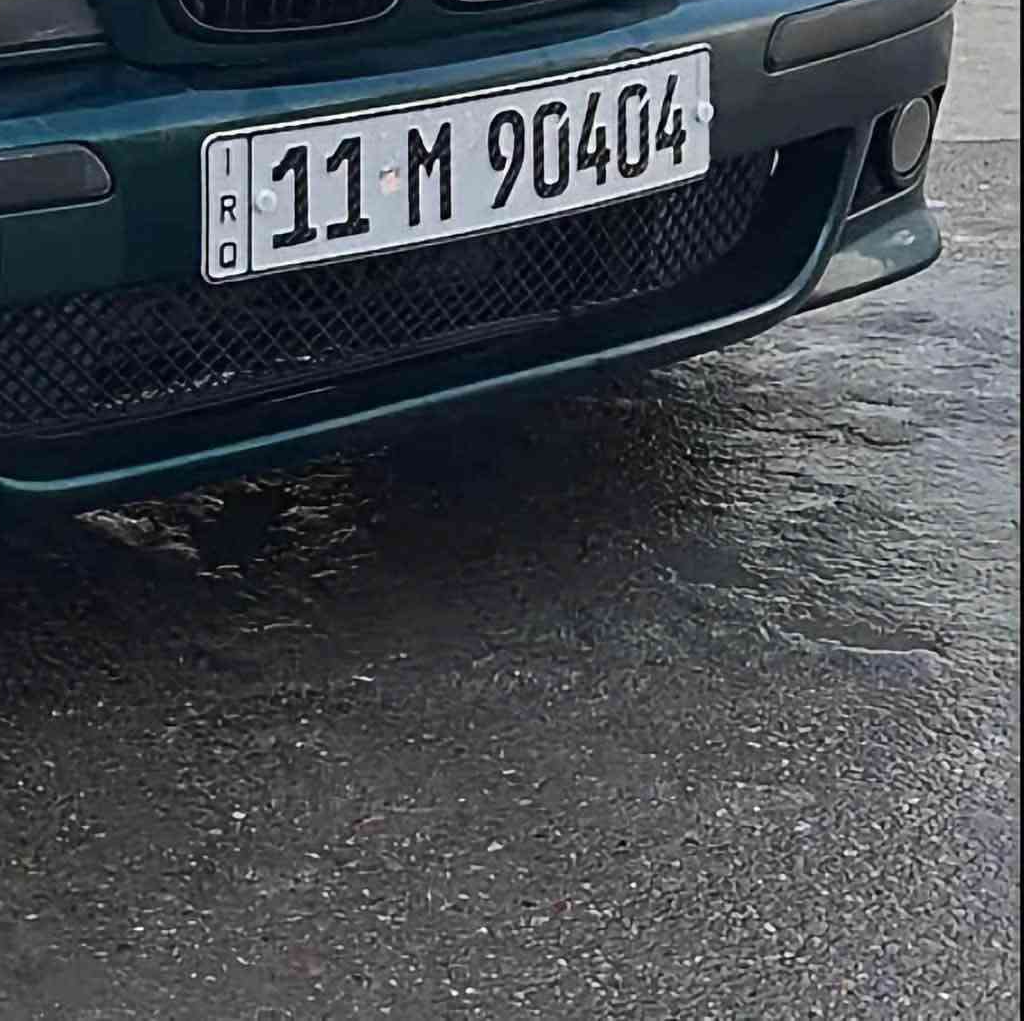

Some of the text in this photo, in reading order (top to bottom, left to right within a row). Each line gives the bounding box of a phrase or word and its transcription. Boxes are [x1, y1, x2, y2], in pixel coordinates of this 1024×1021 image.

[271, 74, 687, 250] 11 M 90404
